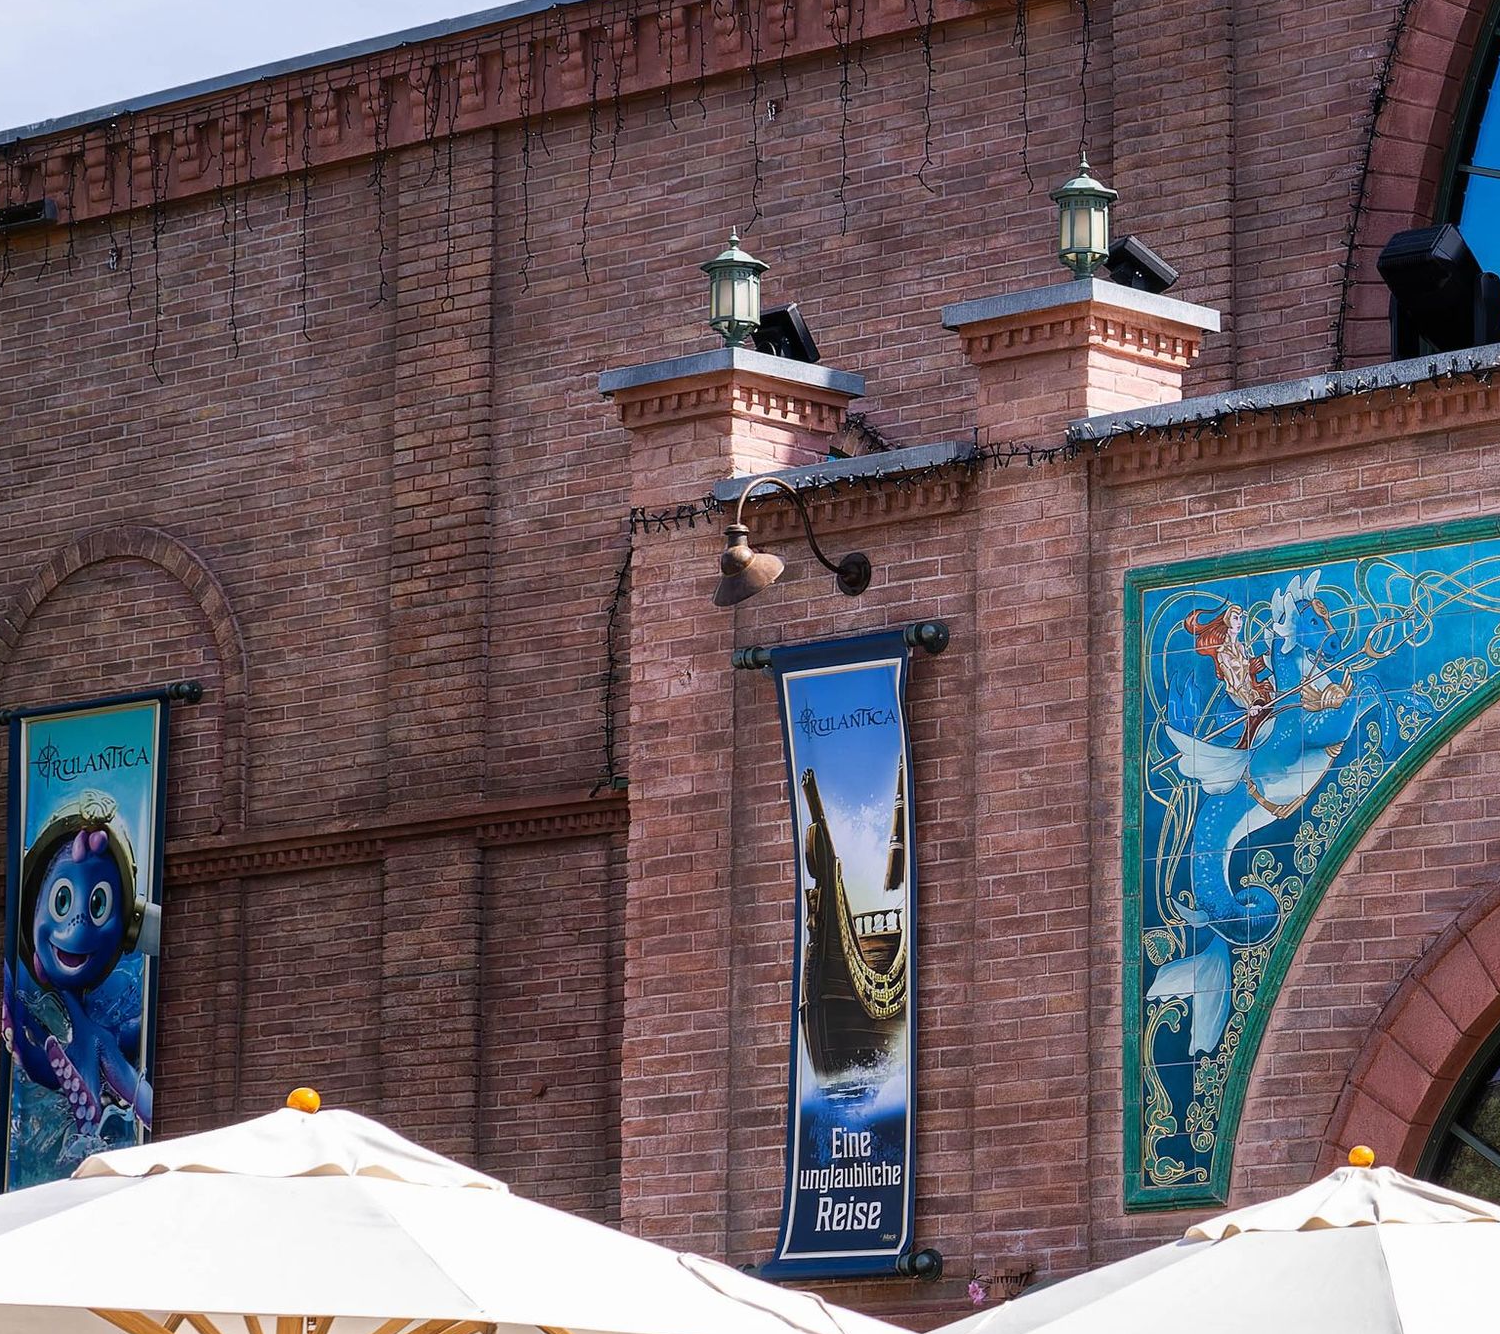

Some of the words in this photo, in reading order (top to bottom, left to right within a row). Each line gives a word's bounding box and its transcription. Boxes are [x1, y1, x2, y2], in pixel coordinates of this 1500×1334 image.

[809, 706, 898, 737] RULANTICA
[51, 744, 151, 782] RULANTICA
[831, 1126, 872, 1159] Eine
[799, 1160, 901, 1194] unglaubliche
[814, 1195, 882, 1232] Reise
